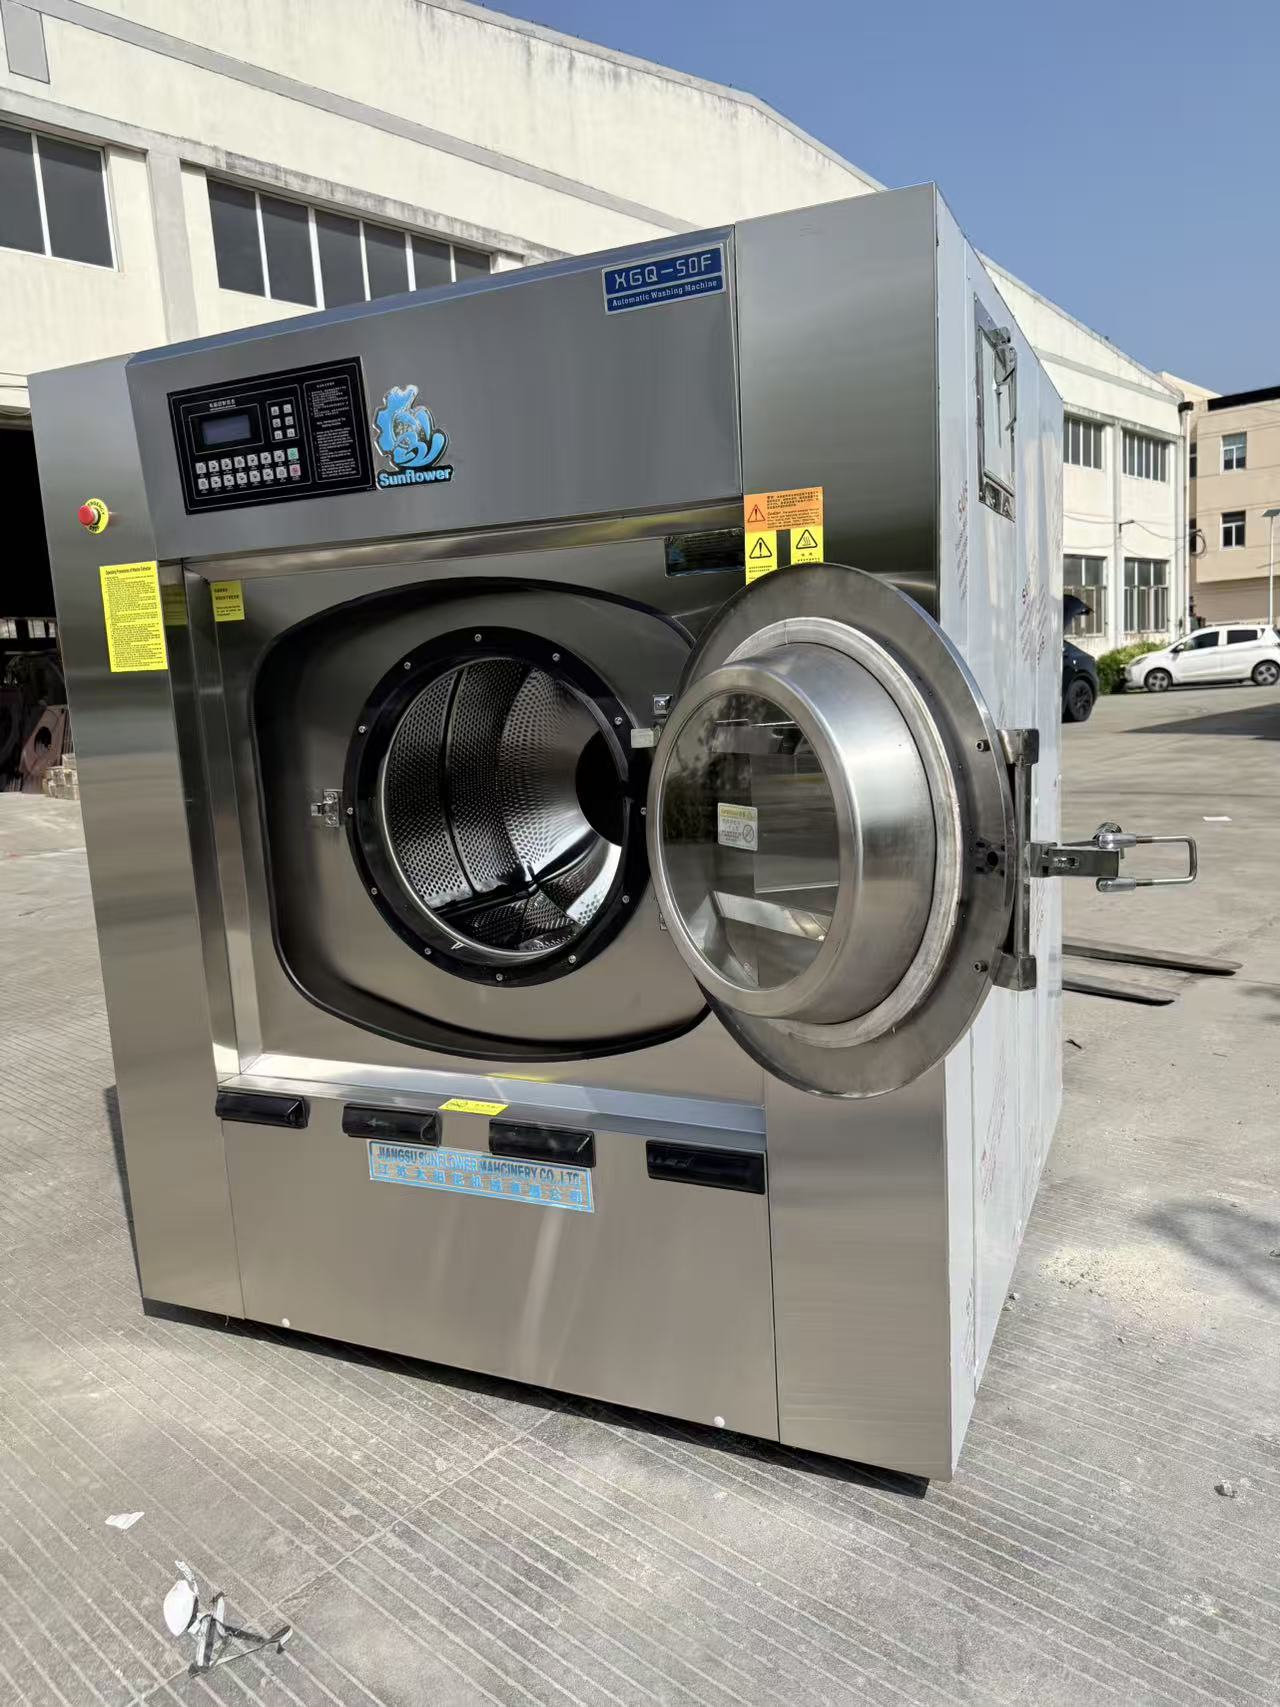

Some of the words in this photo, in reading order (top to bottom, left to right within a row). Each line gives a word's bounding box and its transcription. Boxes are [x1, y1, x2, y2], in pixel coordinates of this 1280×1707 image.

[614, 254, 712, 289] XGQ-50F
[612, 292, 650, 307] Automatic
[651, 285, 683, 300] Washing
[684, 279, 717, 292] Machine
[378, 466, 452, 488] Sunflower
[378, 1146, 417, 1165] JIANGSU
[417, 1151, 478, 1172] SUNFLOWER
